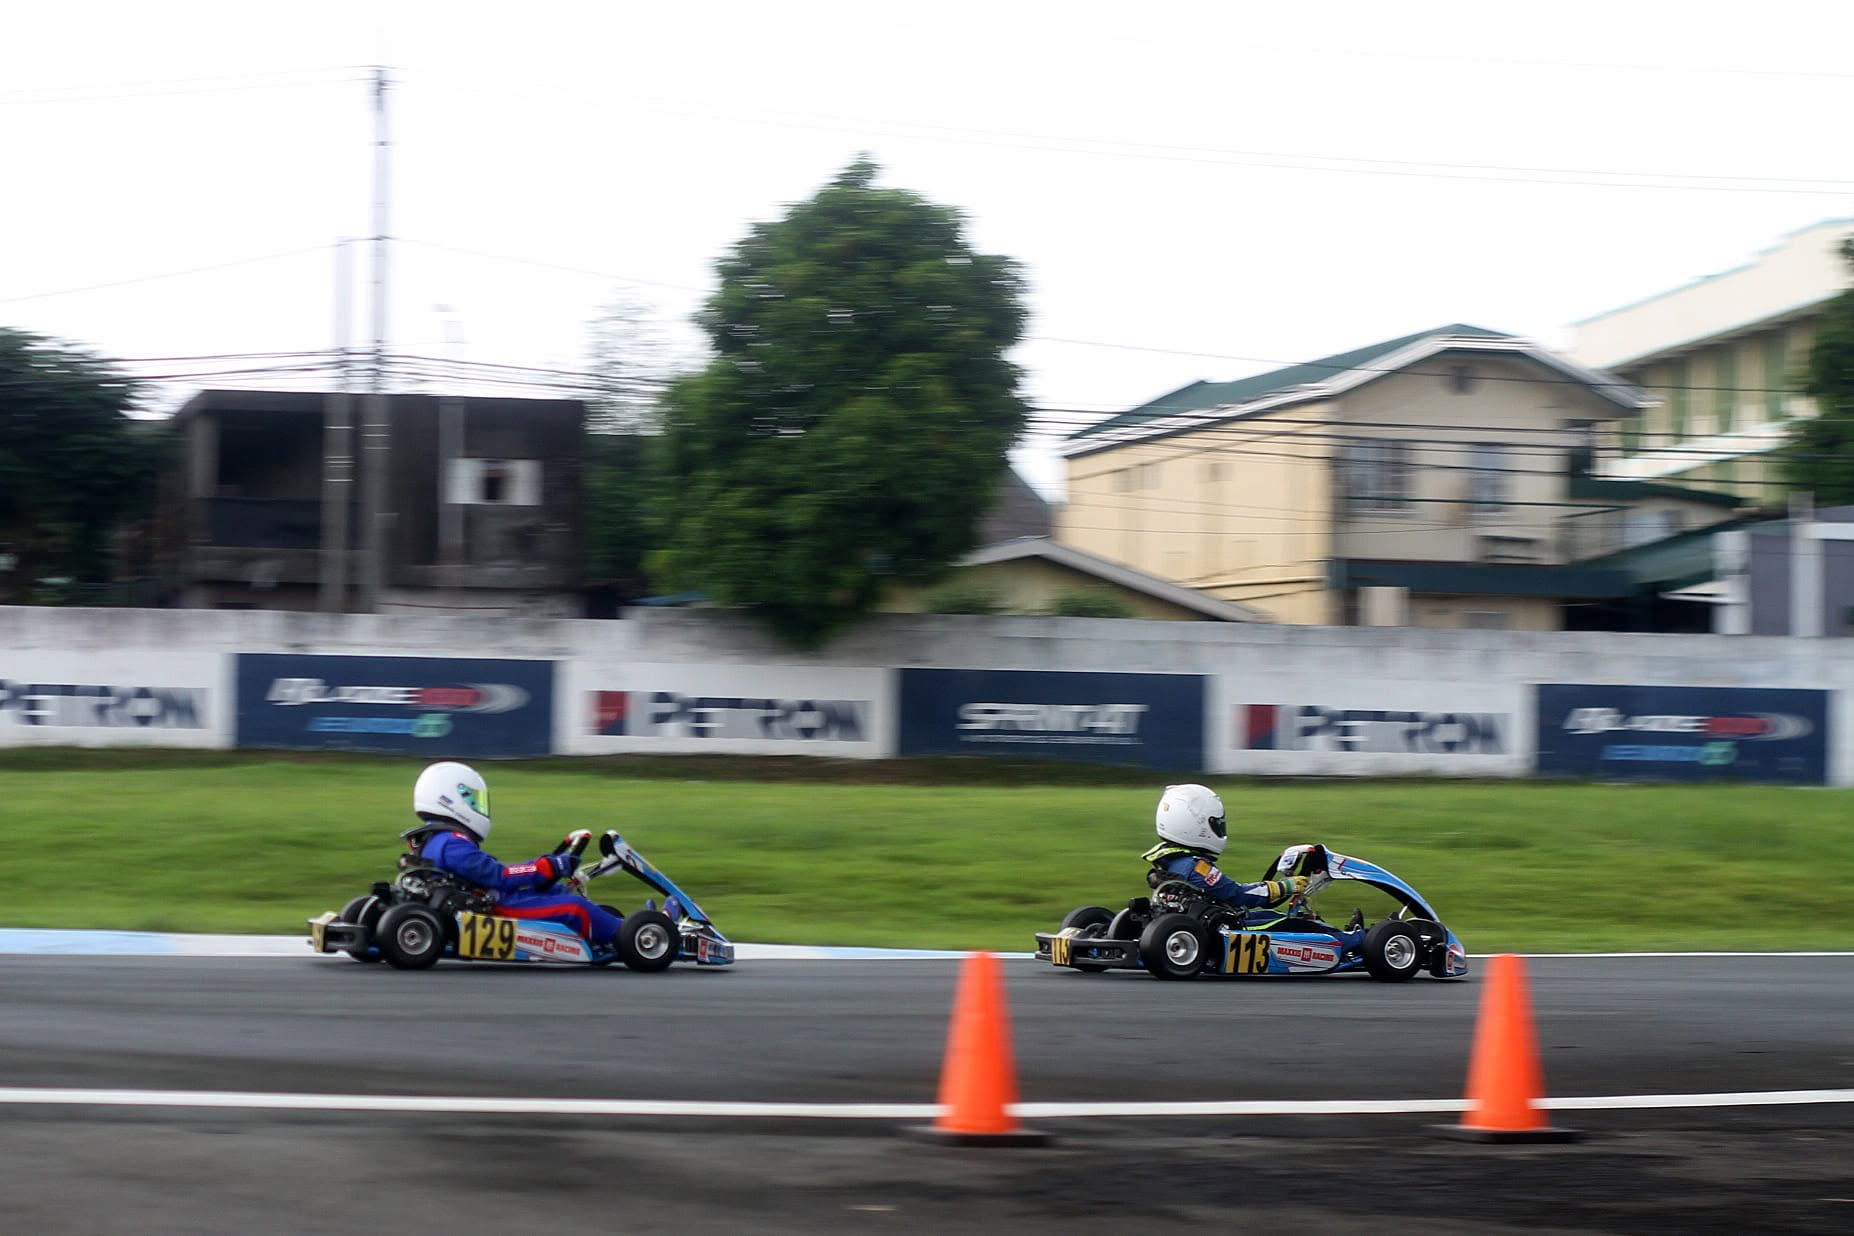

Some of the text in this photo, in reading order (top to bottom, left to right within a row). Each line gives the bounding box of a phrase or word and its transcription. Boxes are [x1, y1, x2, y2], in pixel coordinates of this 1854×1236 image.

[647, 691, 866, 741] PETRON
[1297, 706, 1508, 755] PETRON
[465, 916, 515, 959] 129
[1229, 934, 1271, 974] 113
